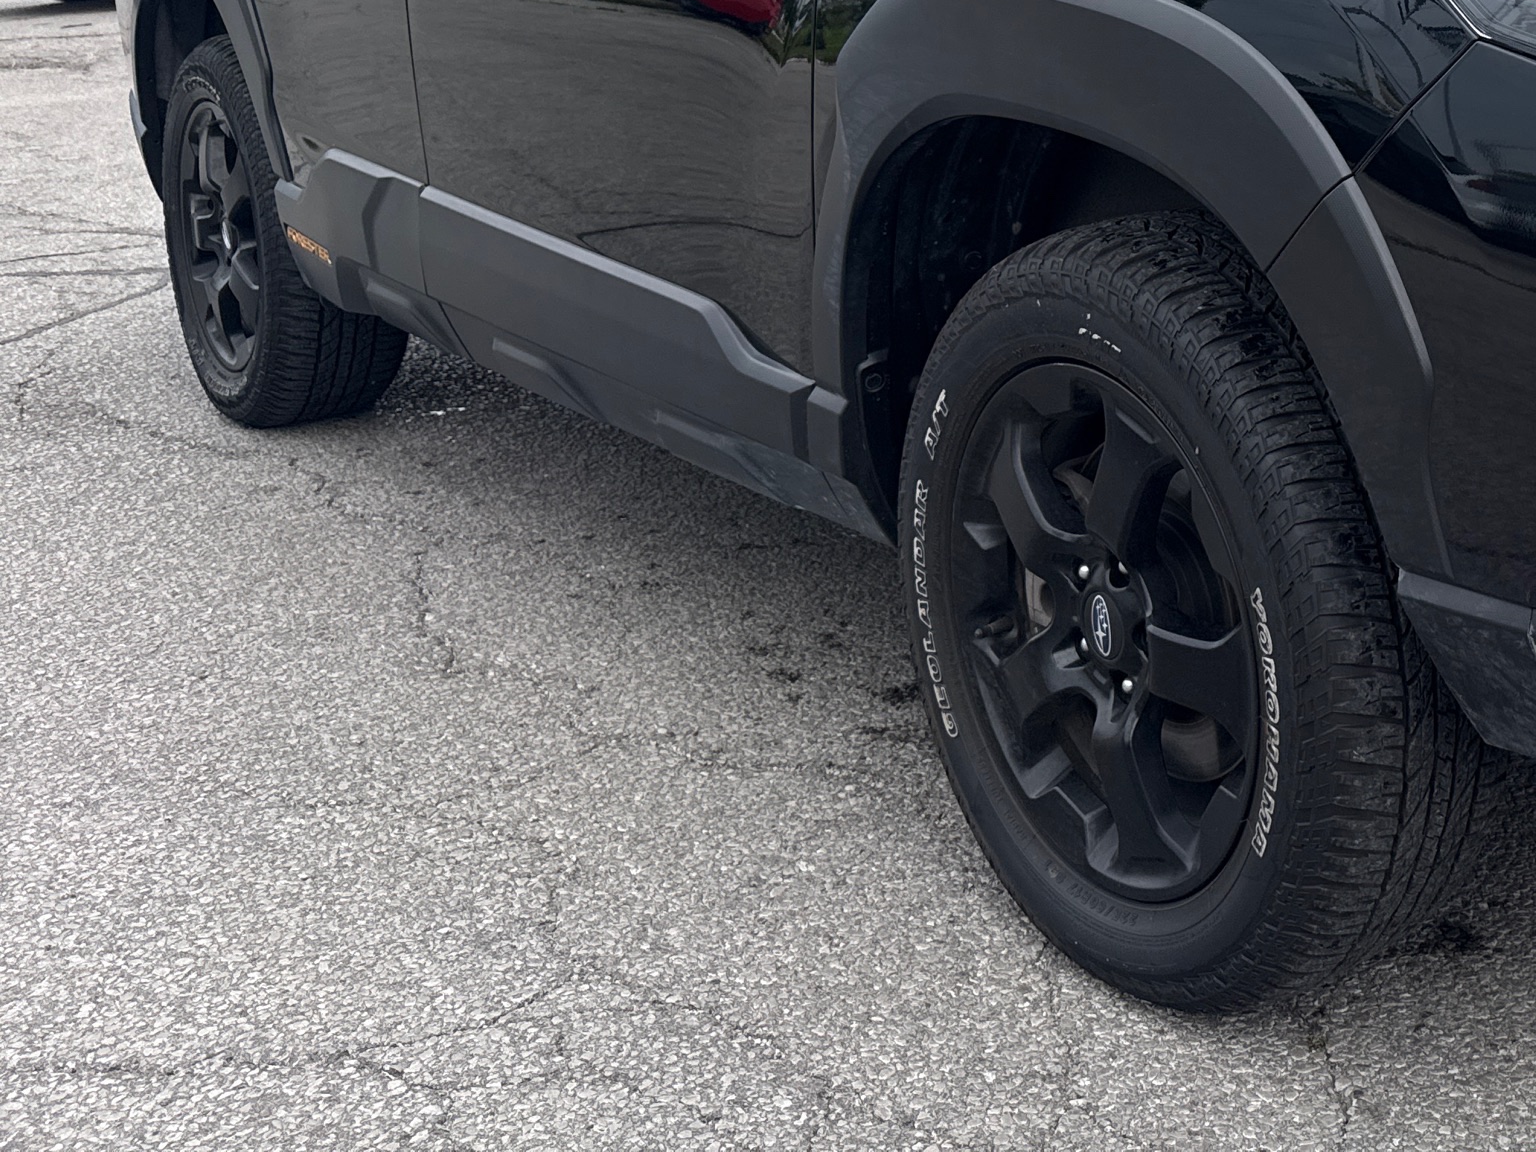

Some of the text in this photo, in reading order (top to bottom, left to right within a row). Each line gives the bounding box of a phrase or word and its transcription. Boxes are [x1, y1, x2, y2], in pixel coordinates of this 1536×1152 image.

[914, 388, 959, 738] GEOLANDAR A/T
[1250, 587, 1280, 858] YOKOHAMA
